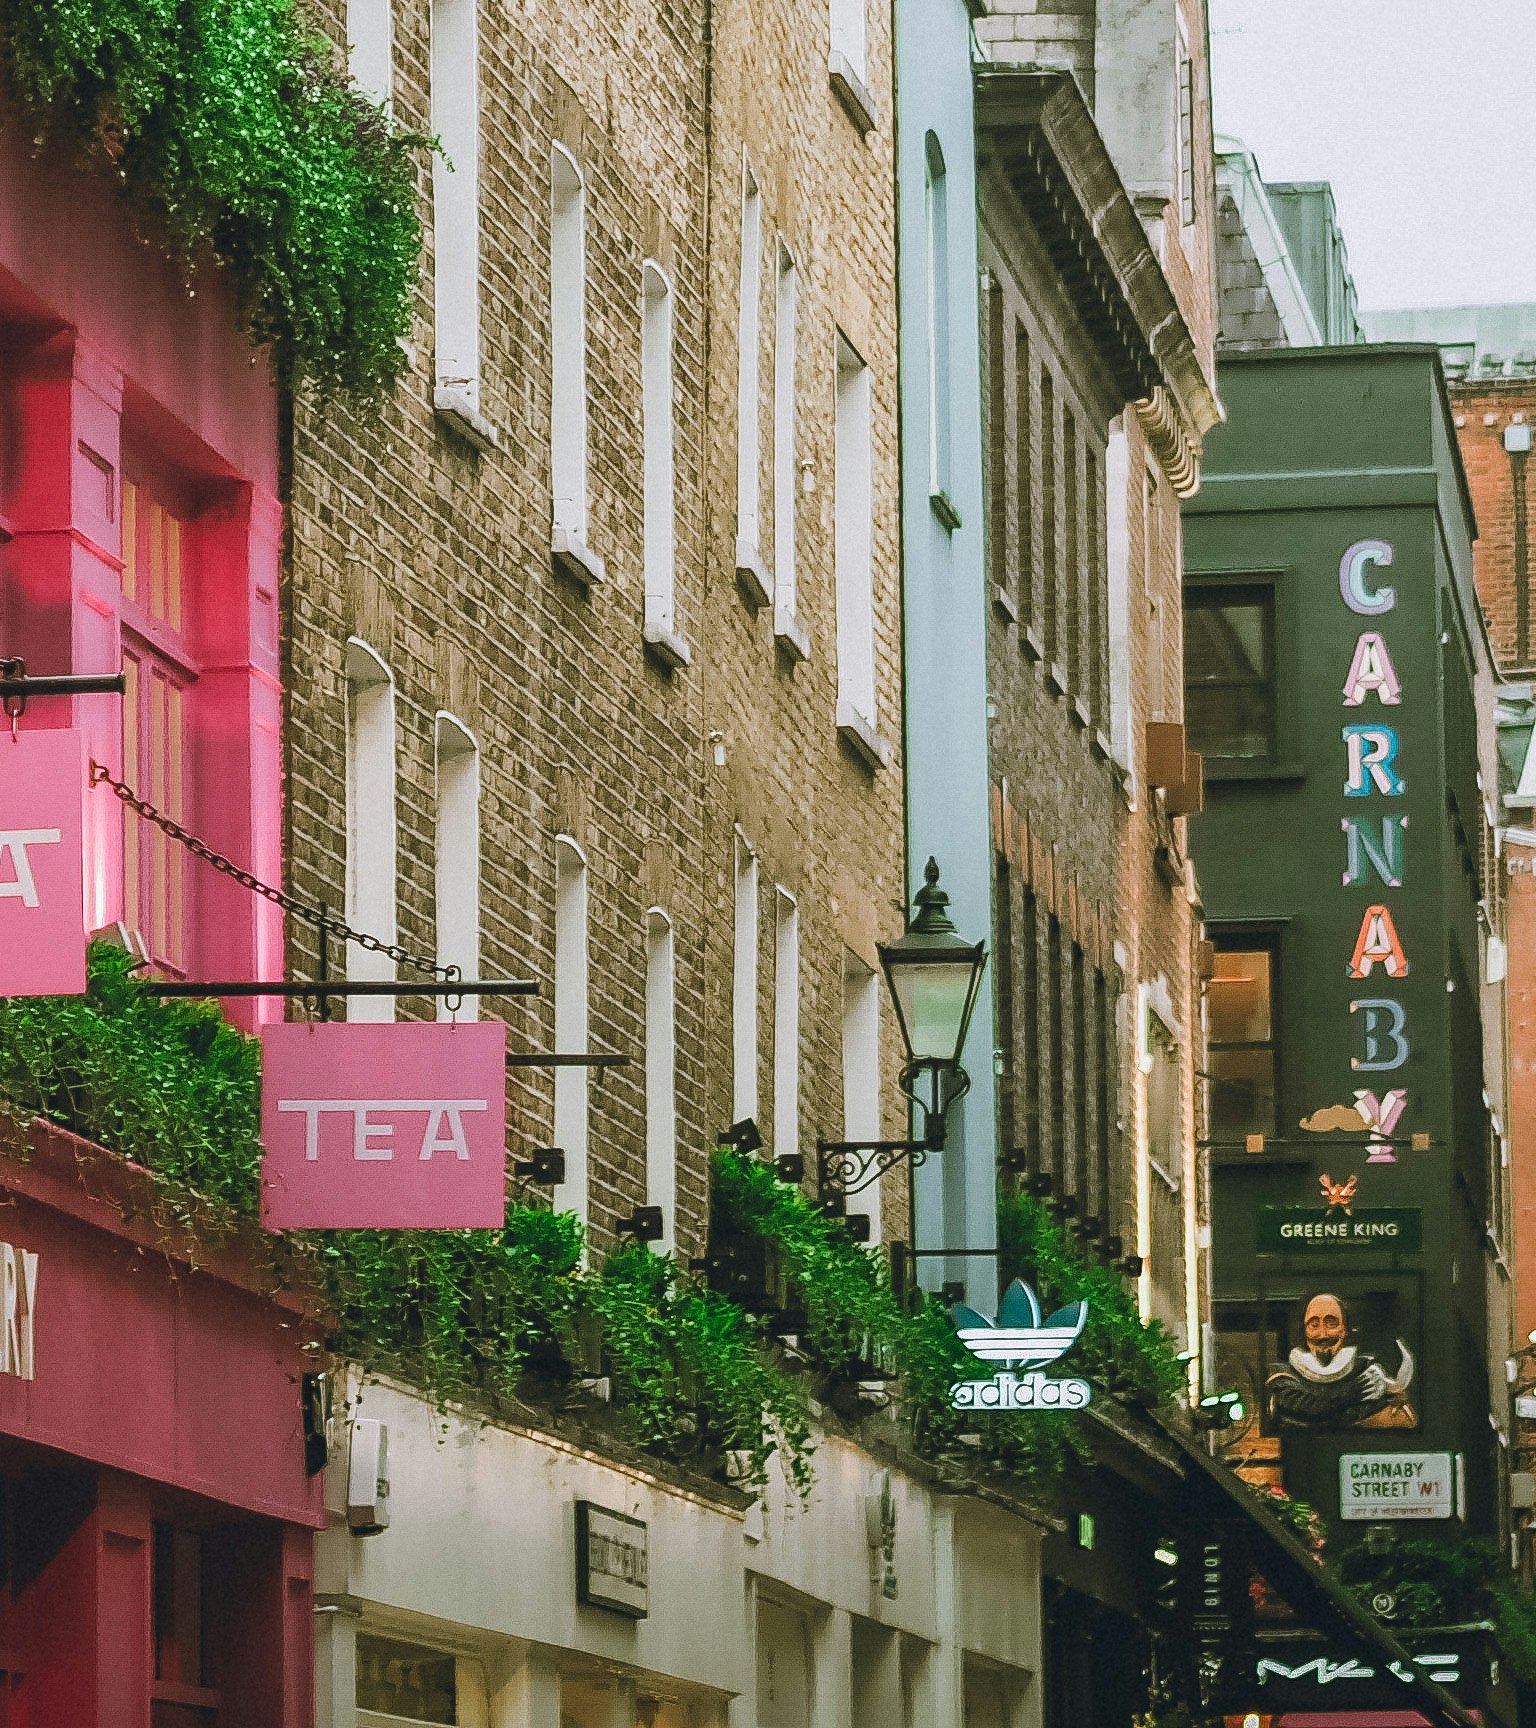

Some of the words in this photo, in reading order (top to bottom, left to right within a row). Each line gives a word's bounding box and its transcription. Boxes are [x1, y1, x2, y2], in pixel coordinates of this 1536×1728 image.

[1339, 538, 1410, 1164] CARNABY
[278, 1099, 487, 1161] TEA
[1280, 1223, 1347, 1237] GREENE
[1354, 1223, 1399, 1237] KING
[949, 1372, 1090, 1409] adidas
[1351, 1463, 1424, 1478] CARNABY
[1352, 1482, 1409, 1497] STREET
